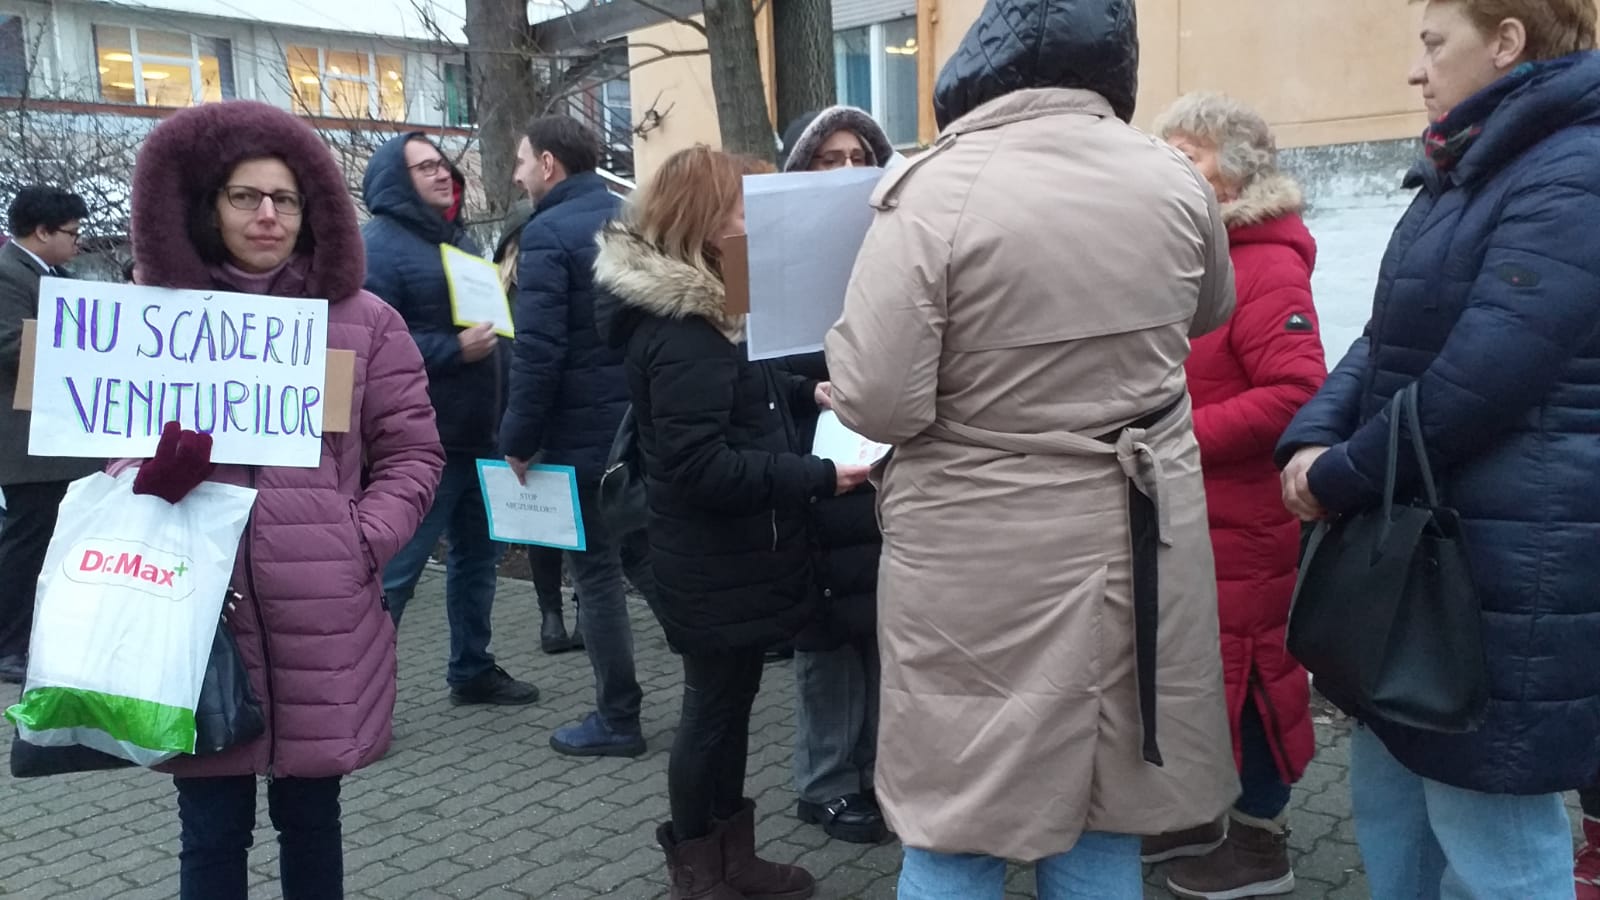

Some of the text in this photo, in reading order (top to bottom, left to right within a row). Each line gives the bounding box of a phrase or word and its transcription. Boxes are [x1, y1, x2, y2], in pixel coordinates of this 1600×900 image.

[53, 297, 121, 353] NU
[64, 374, 322, 438] VENITURILOR
[520, 492, 539, 501] STOP
